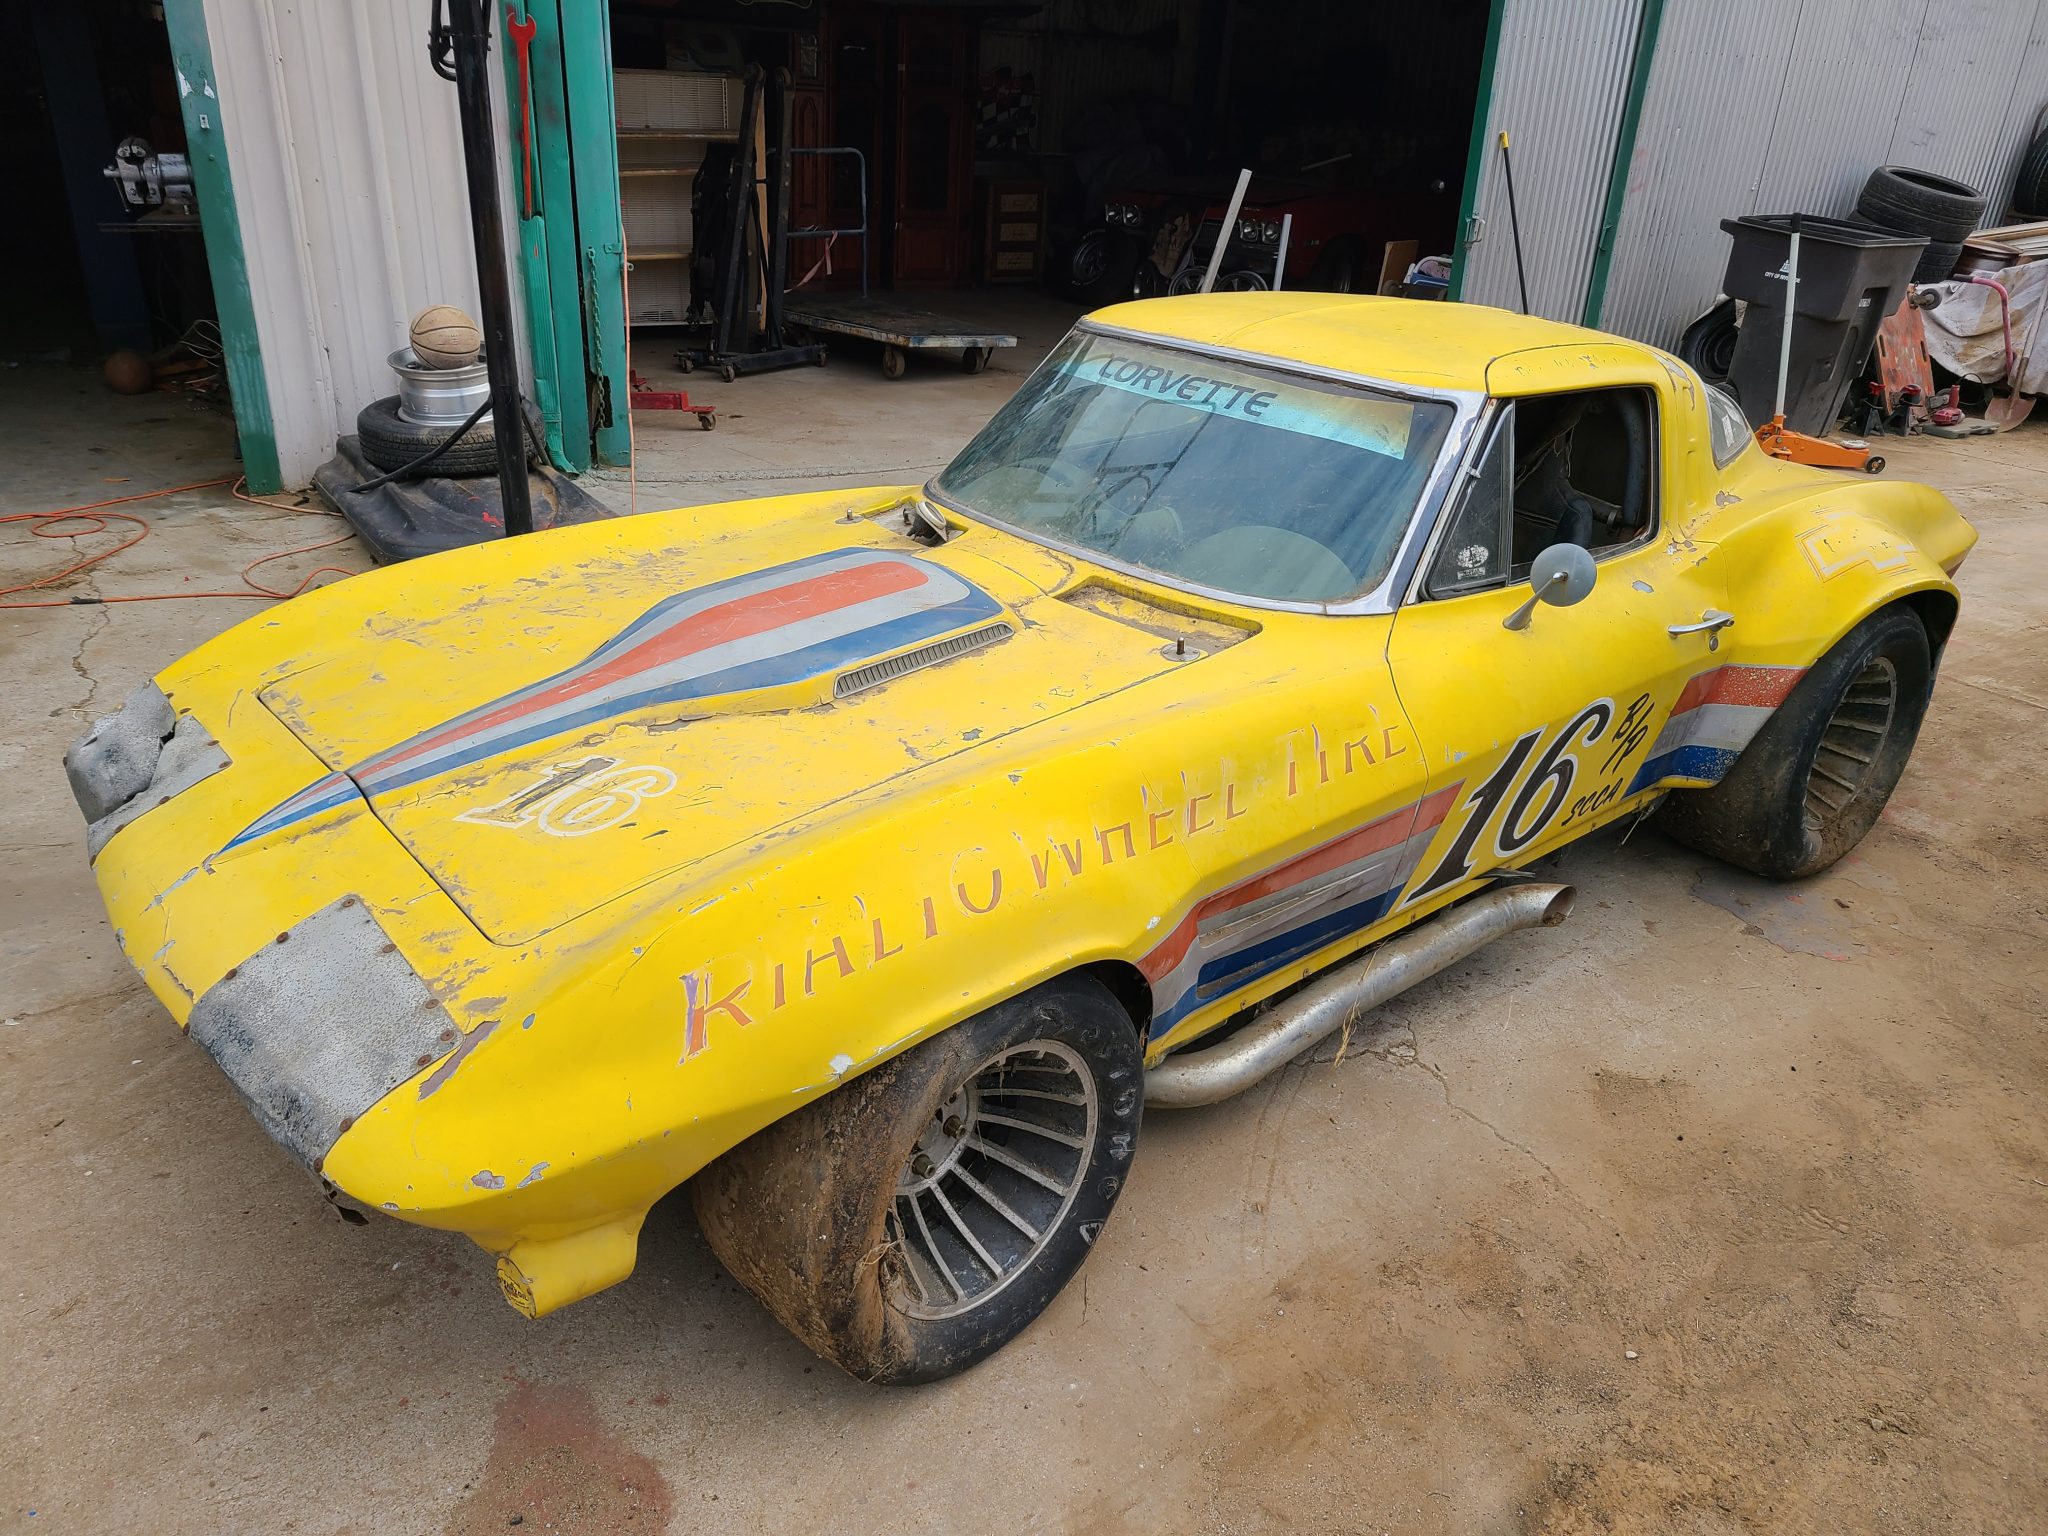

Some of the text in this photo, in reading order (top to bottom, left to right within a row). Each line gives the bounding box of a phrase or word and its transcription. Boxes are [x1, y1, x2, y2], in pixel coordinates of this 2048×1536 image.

[1099, 356, 1278, 417] CORVETTE
[452, 754, 678, 838] 16
[1395, 696, 1615, 914] 16
[1561, 777, 1624, 827] SCCA
